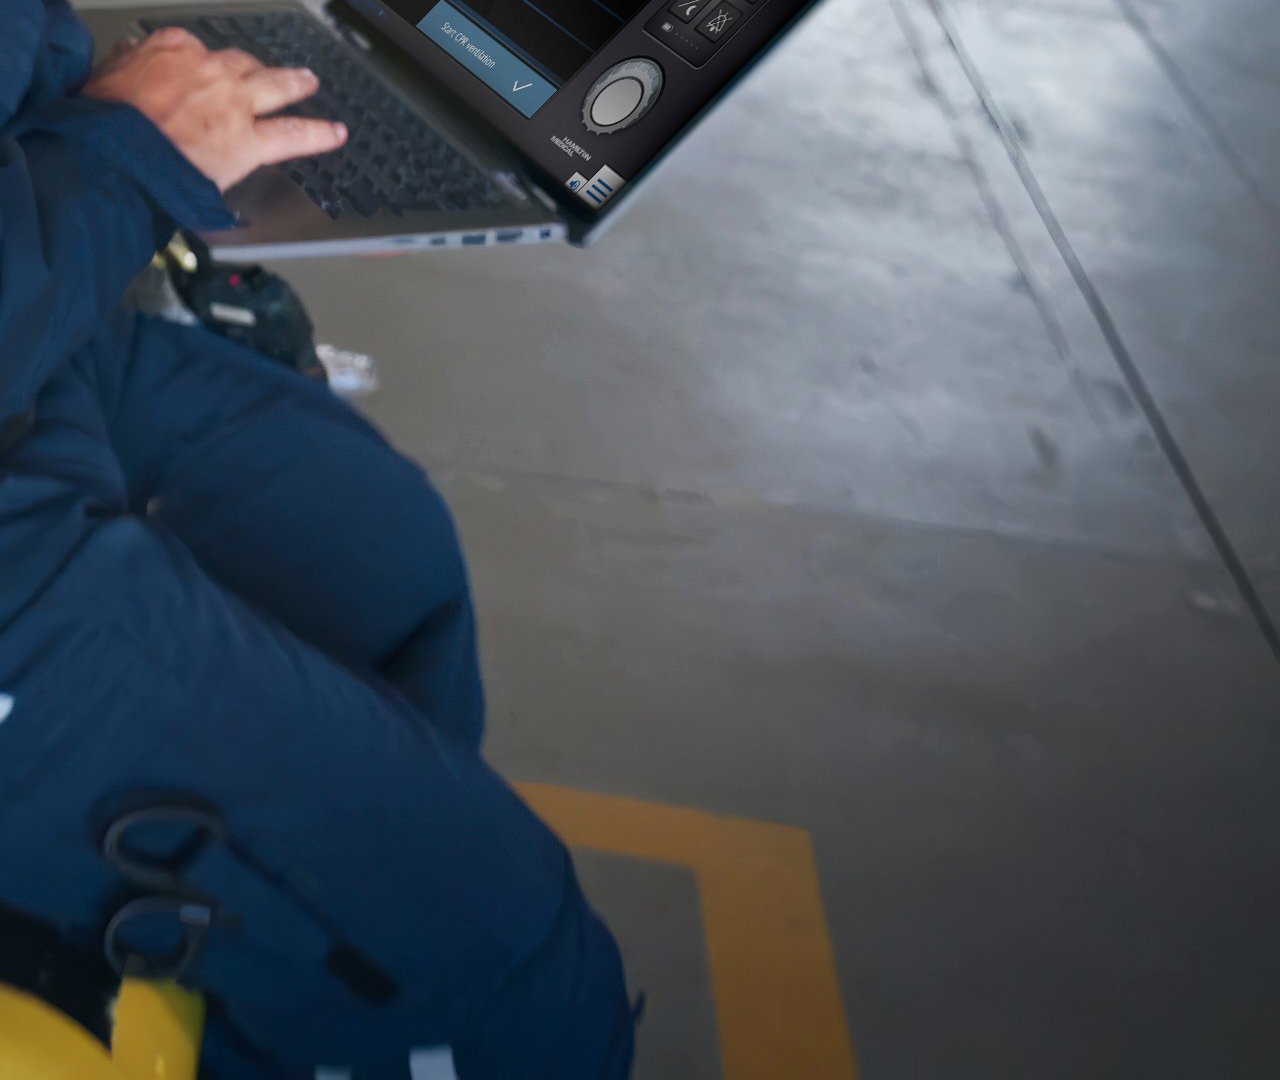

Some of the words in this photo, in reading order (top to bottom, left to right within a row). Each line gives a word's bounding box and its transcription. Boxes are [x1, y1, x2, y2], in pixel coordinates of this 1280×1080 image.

[441, 22, 456, 37] Start
[454, 33, 468, 47] CPR
[466, 40, 496, 69] ventilation
